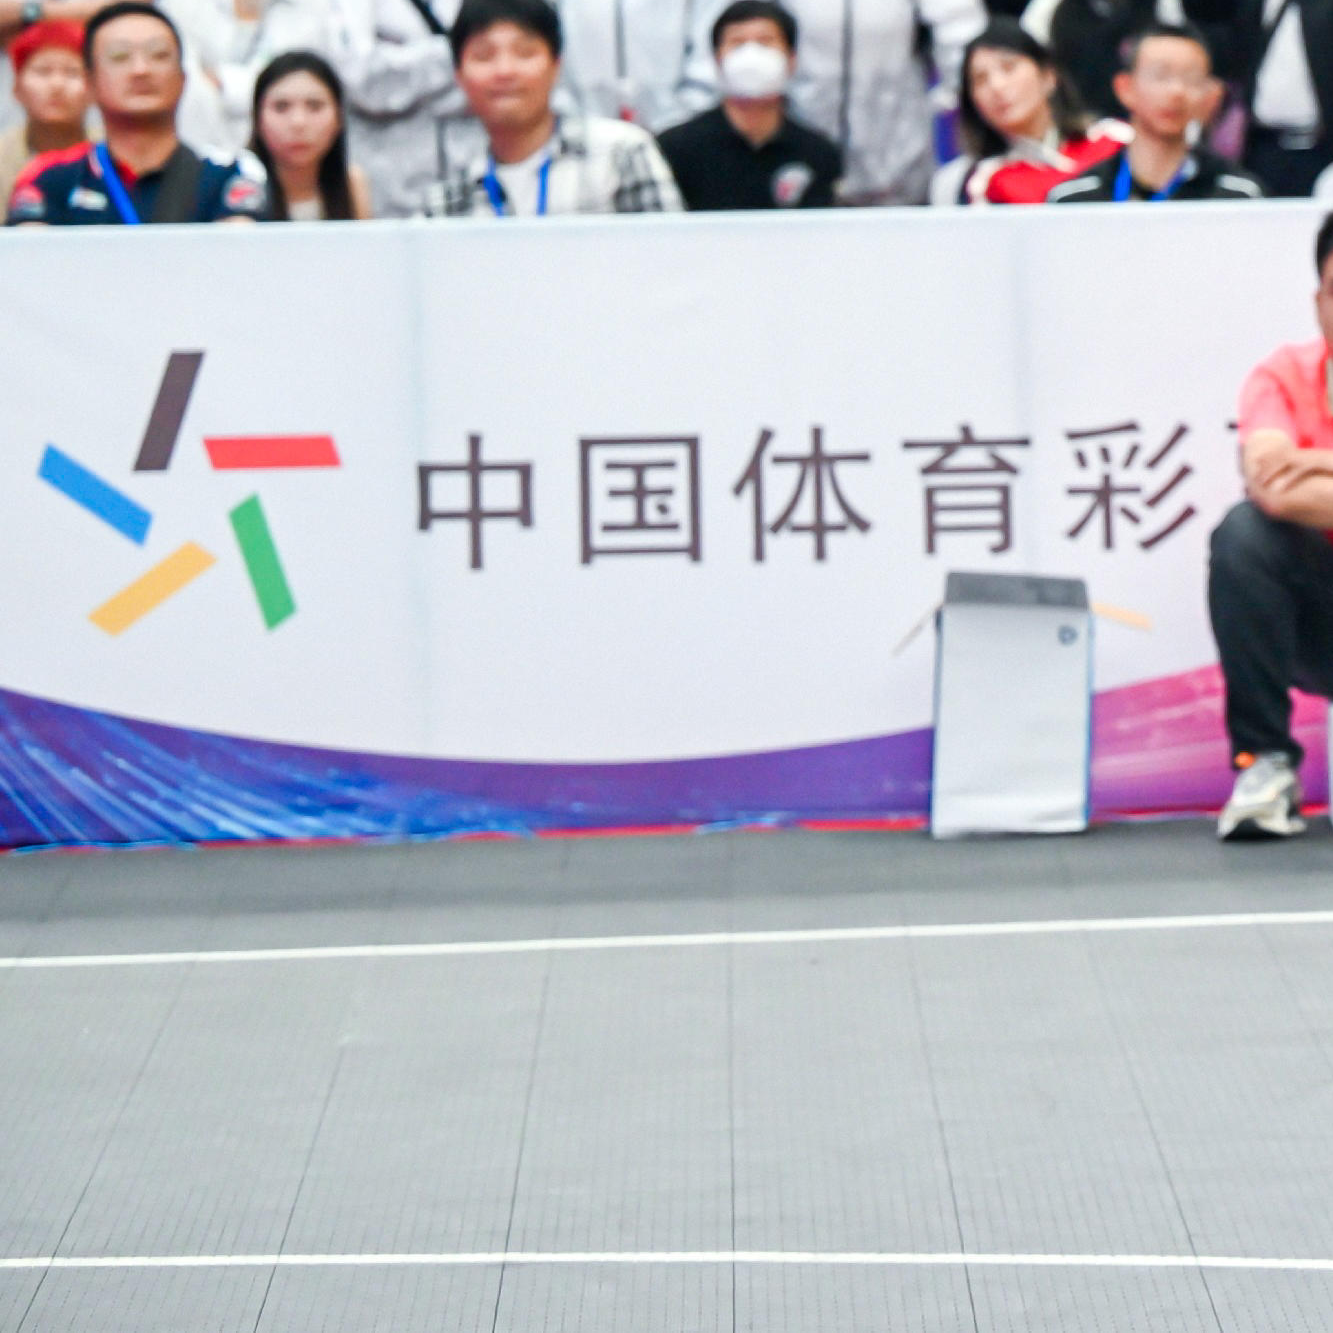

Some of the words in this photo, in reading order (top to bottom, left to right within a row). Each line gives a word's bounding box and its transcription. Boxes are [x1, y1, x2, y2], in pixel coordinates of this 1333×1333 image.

[416, 421, 1240, 571] 中国体育彩
